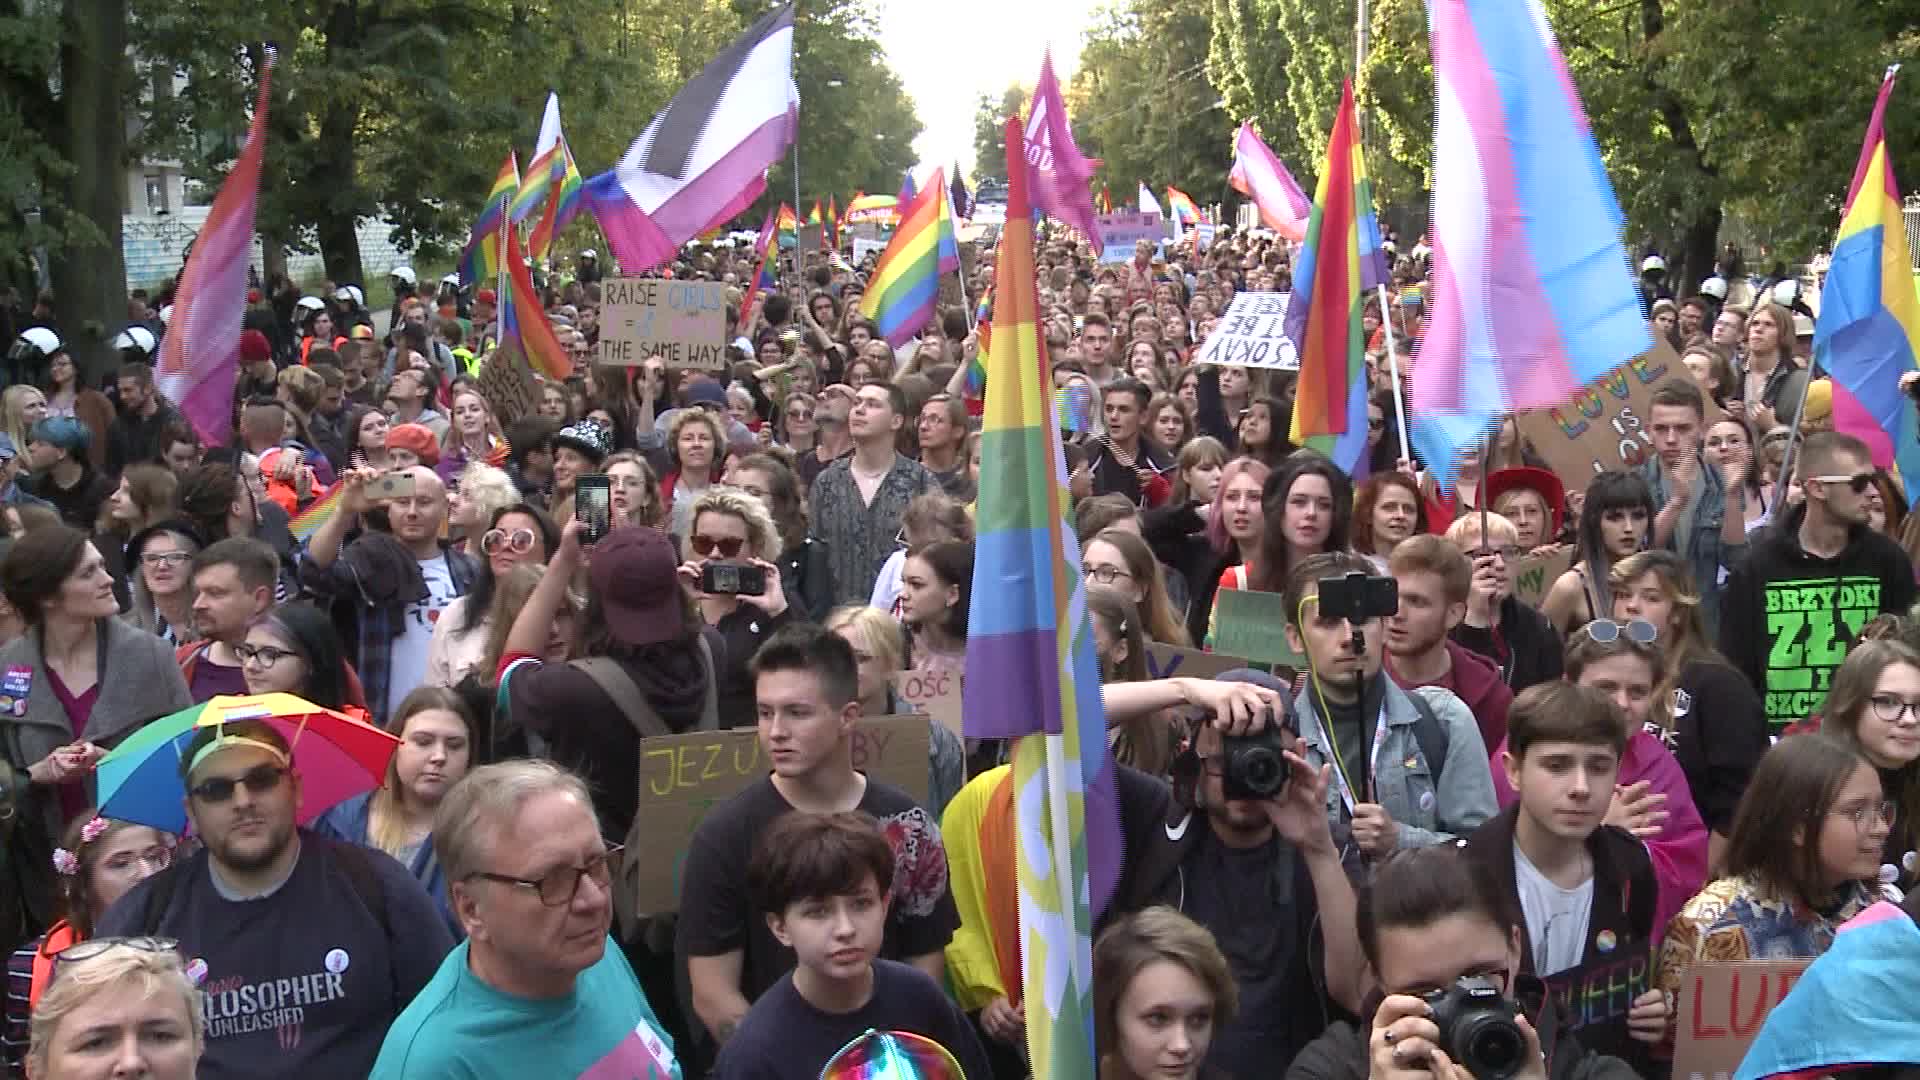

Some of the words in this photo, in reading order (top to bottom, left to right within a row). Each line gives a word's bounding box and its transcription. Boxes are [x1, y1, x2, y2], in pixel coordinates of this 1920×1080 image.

[606, 283, 656, 306] RAISE
[1233, 296, 1285, 315] SELF
[1225, 315, 1259, 336] BE
[602, 340, 632, 360] THE
[640, 341, 681, 361] SAME
[688, 343, 721, 363] WAY
[1206, 337, 1269, 363] OKAY
[1552, 357, 1668, 440] LOVE
[1611, 407, 1640, 435] IS
[1765, 584, 1880, 612] BRZYDKI
[905, 670, 950, 698] OŚĆ
[1816, 668, 1832, 690] I
[1765, 690, 1829, 716] SZCZ
[645, 739, 760, 796] JEZU
[205, 973, 345, 1020] LOSOPHER
[207, 1007, 304, 1038] UNLEASHED
